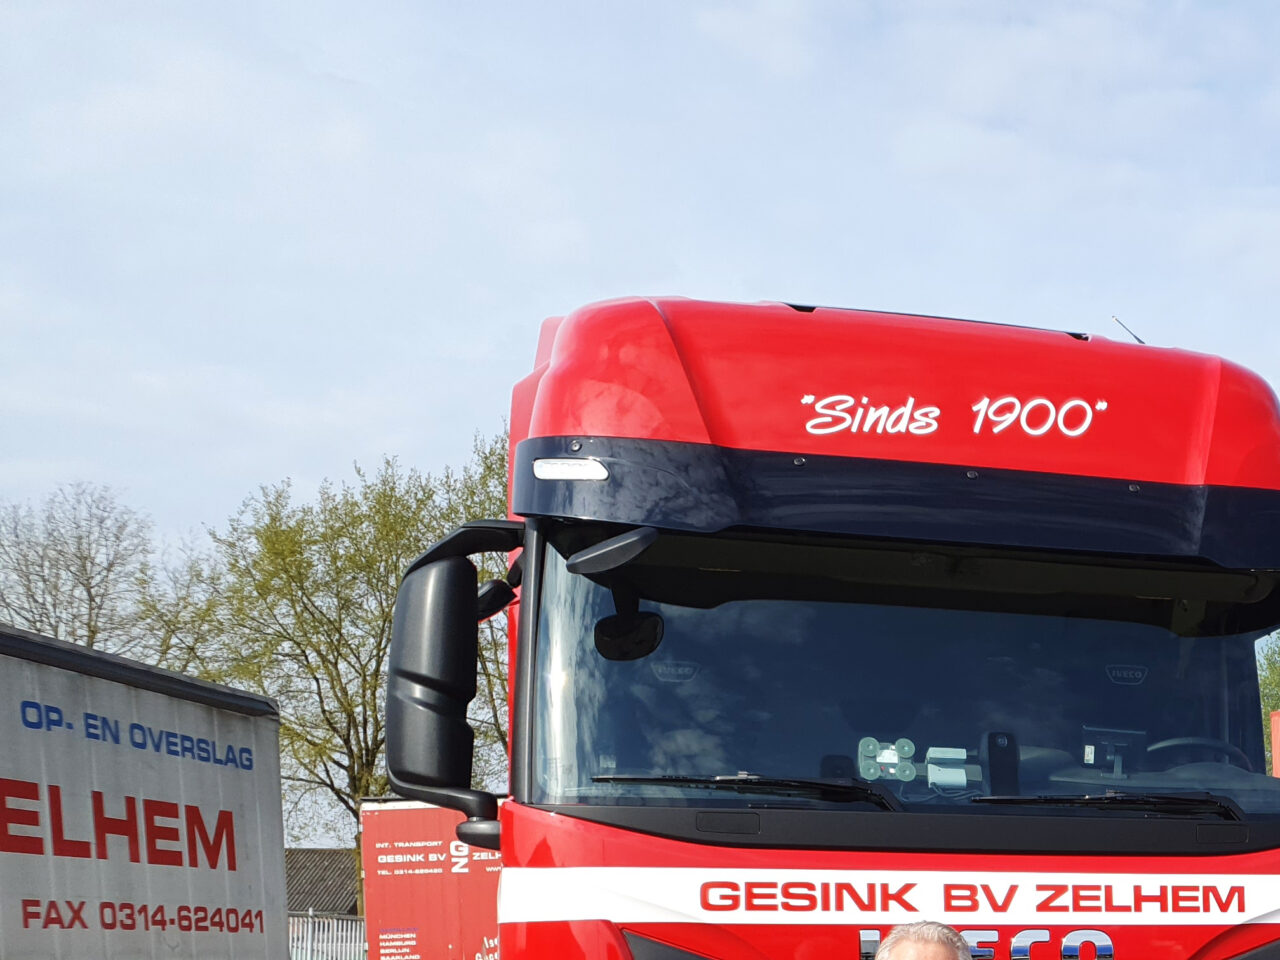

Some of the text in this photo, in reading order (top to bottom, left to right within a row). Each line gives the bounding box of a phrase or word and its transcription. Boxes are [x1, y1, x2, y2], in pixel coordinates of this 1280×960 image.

[971, 396, 1108, 437] 1900"
[83, 712, 120, 744] EN
[129, 722, 253, 771] OVERSLAG
[0, 777, 237, 872] ELHEM
[377, 853, 447, 863] GESINK BV
[699, 881, 1246, 914] GESINK BV ZELHEM
[21, 900, 264, 934] FAX 0314-624041
